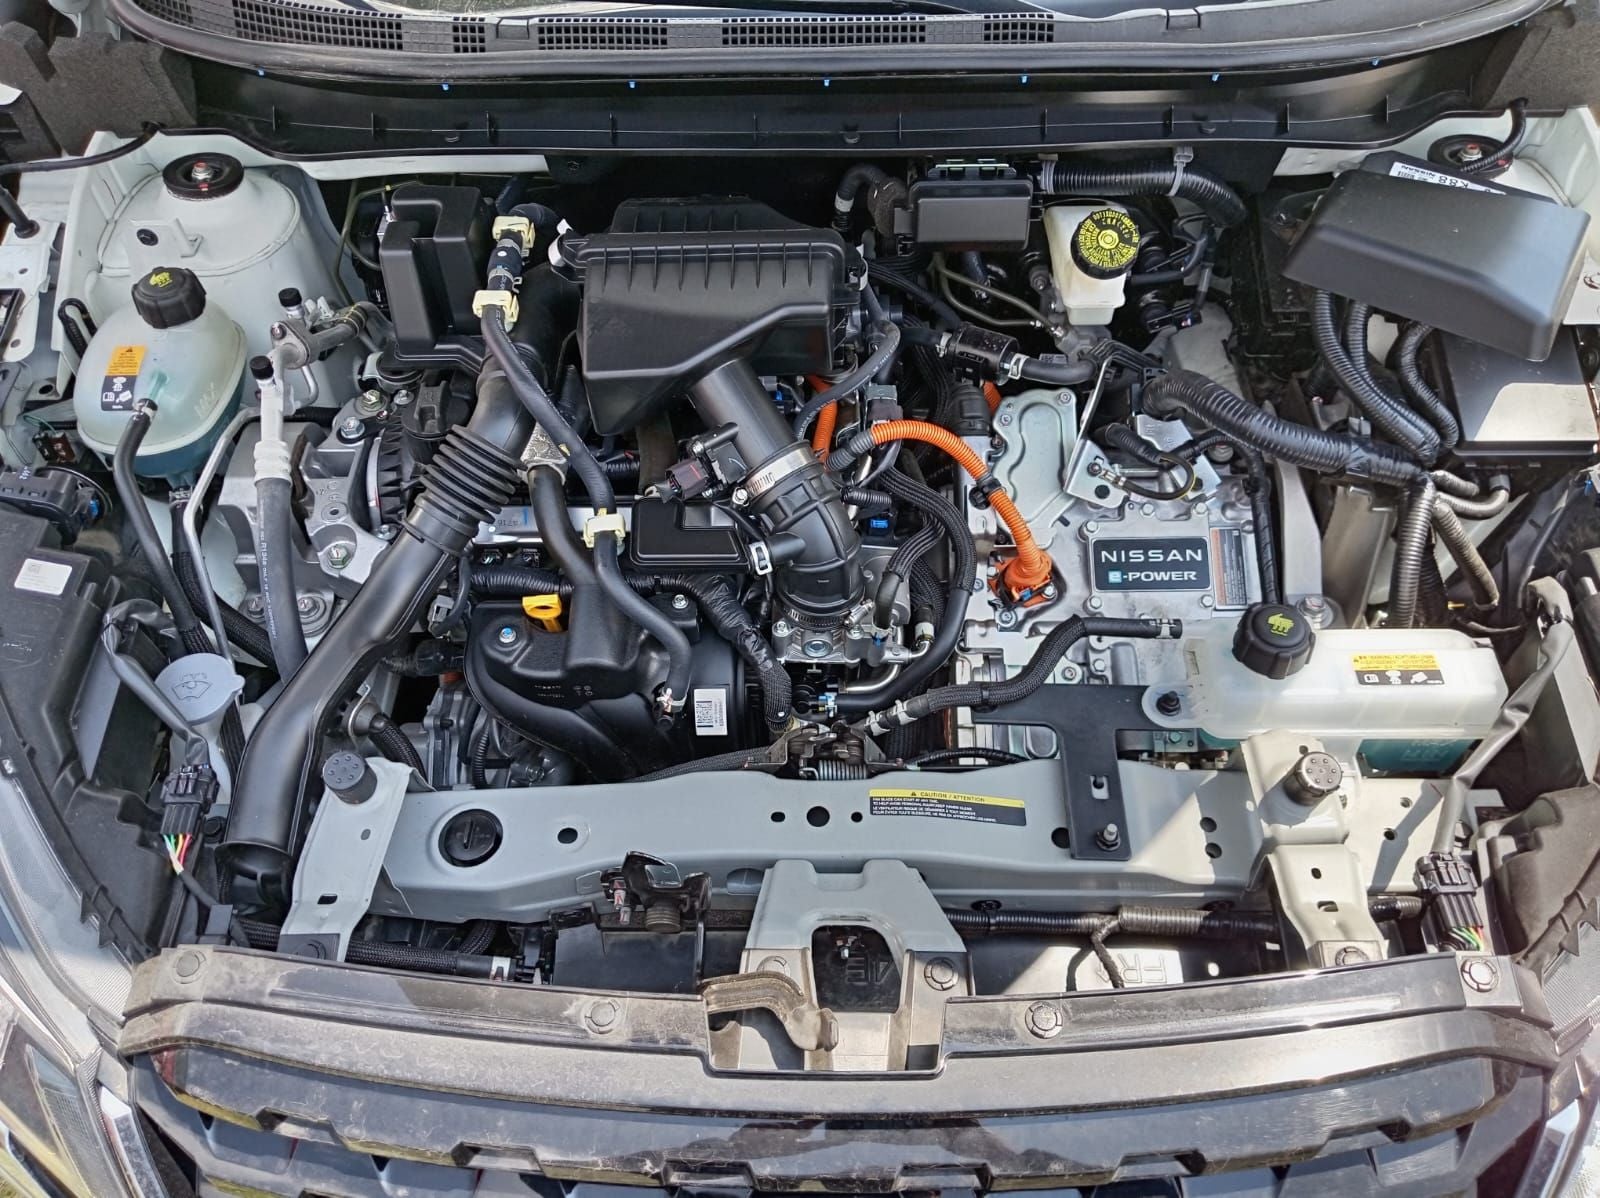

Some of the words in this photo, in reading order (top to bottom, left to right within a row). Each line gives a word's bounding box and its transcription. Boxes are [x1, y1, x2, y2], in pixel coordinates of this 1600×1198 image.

[1101, 549, 1203, 563] NISSAN
[1108, 570, 1197, 584] e-POWER
[1117, 953, 1167, 983] FR
